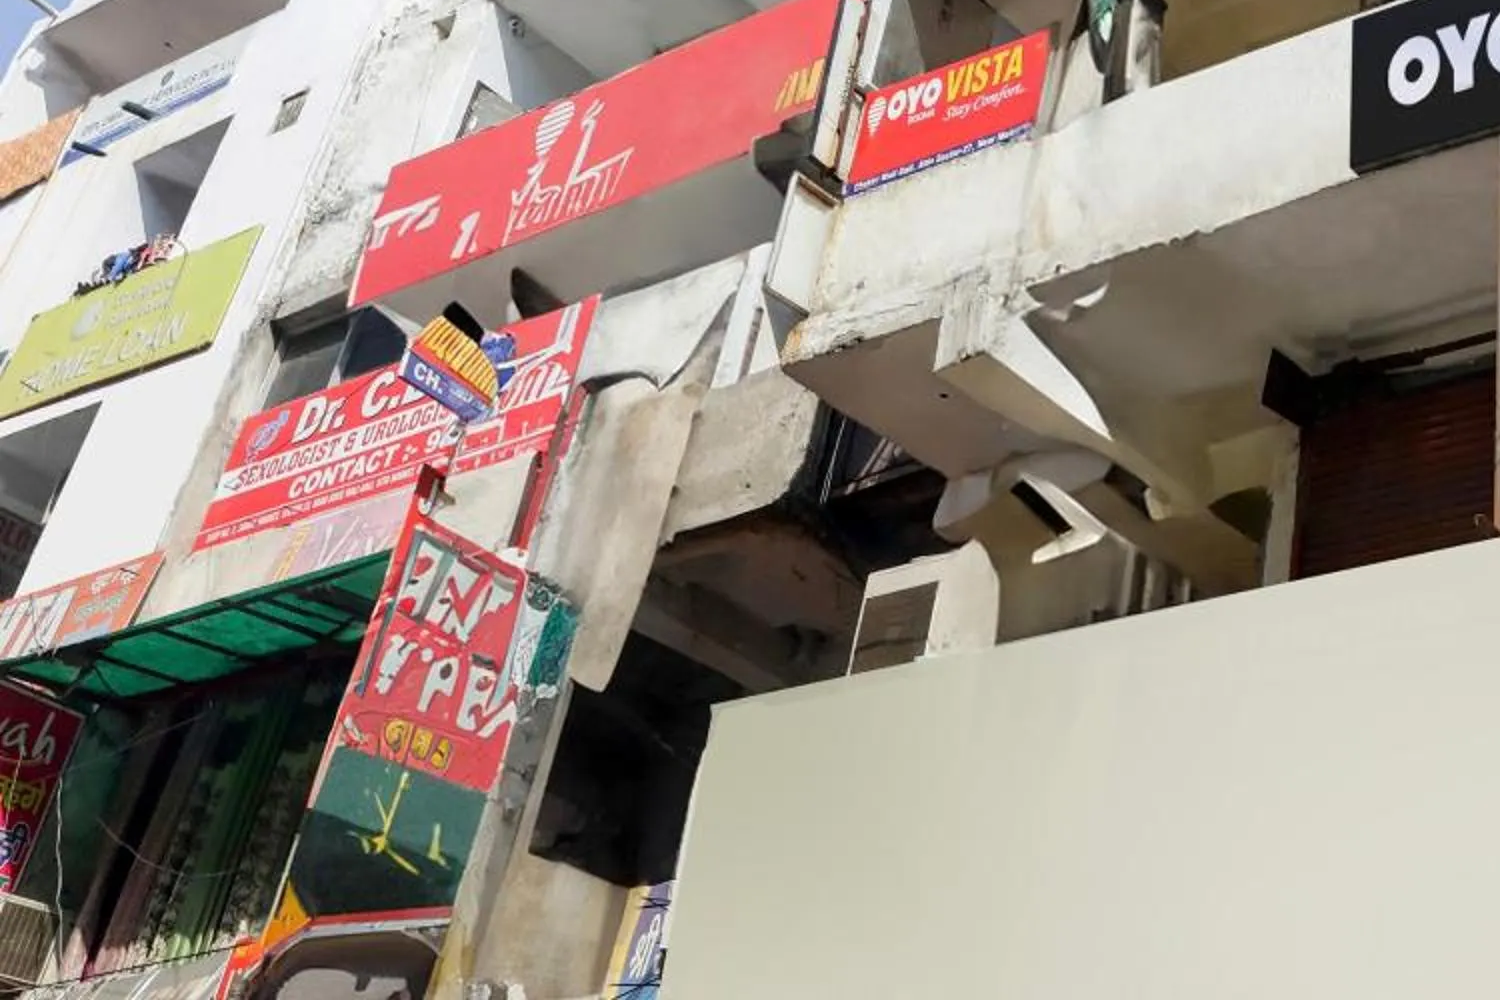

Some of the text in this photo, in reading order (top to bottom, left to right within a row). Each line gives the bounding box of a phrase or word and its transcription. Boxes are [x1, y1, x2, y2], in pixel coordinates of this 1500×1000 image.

[888, 44, 1023, 120] OYO VISTA
[942, 99, 972, 121] Stay
[414, 362, 444, 395] CH.
[238, 437, 338, 487] SEXOLOGIST
[361, 401, 457, 447] UROLOGIS
[292, 394, 347, 444] Dr.
[289, 449, 399, 499] CONTACT
